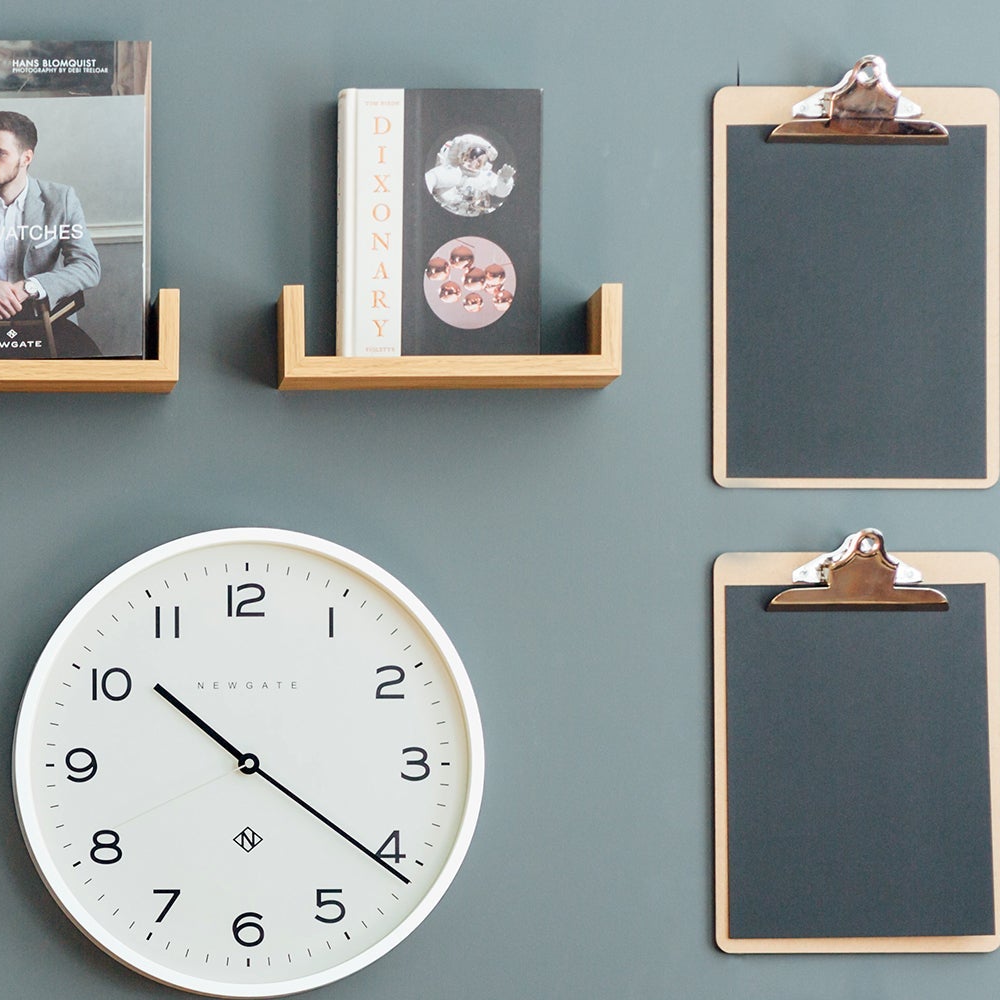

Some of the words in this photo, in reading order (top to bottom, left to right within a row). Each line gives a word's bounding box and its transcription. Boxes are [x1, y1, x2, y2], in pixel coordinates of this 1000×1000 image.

[12, 59, 39, 67] HANS
[42, 59, 96, 68] BLOMQUIST
[372, 117, 392, 338] DIXONARY
[227, 582, 266, 617] 12
[155, 606, 180, 638] 11
[328, 607, 334, 638] 1
[91, 667, 132, 701] 10
[197, 681, 298, 690] NEWGATE
[375, 665, 405, 699] 2
[65, 747, 98, 783] 9
[401, 746, 431, 782] 3
[89, 829, 123, 865] 8
[374, 830, 406, 864] 4
[152, 889, 181, 923] 7
[314, 888, 346, 924] 5
[232, 912, 265, 947] 6
